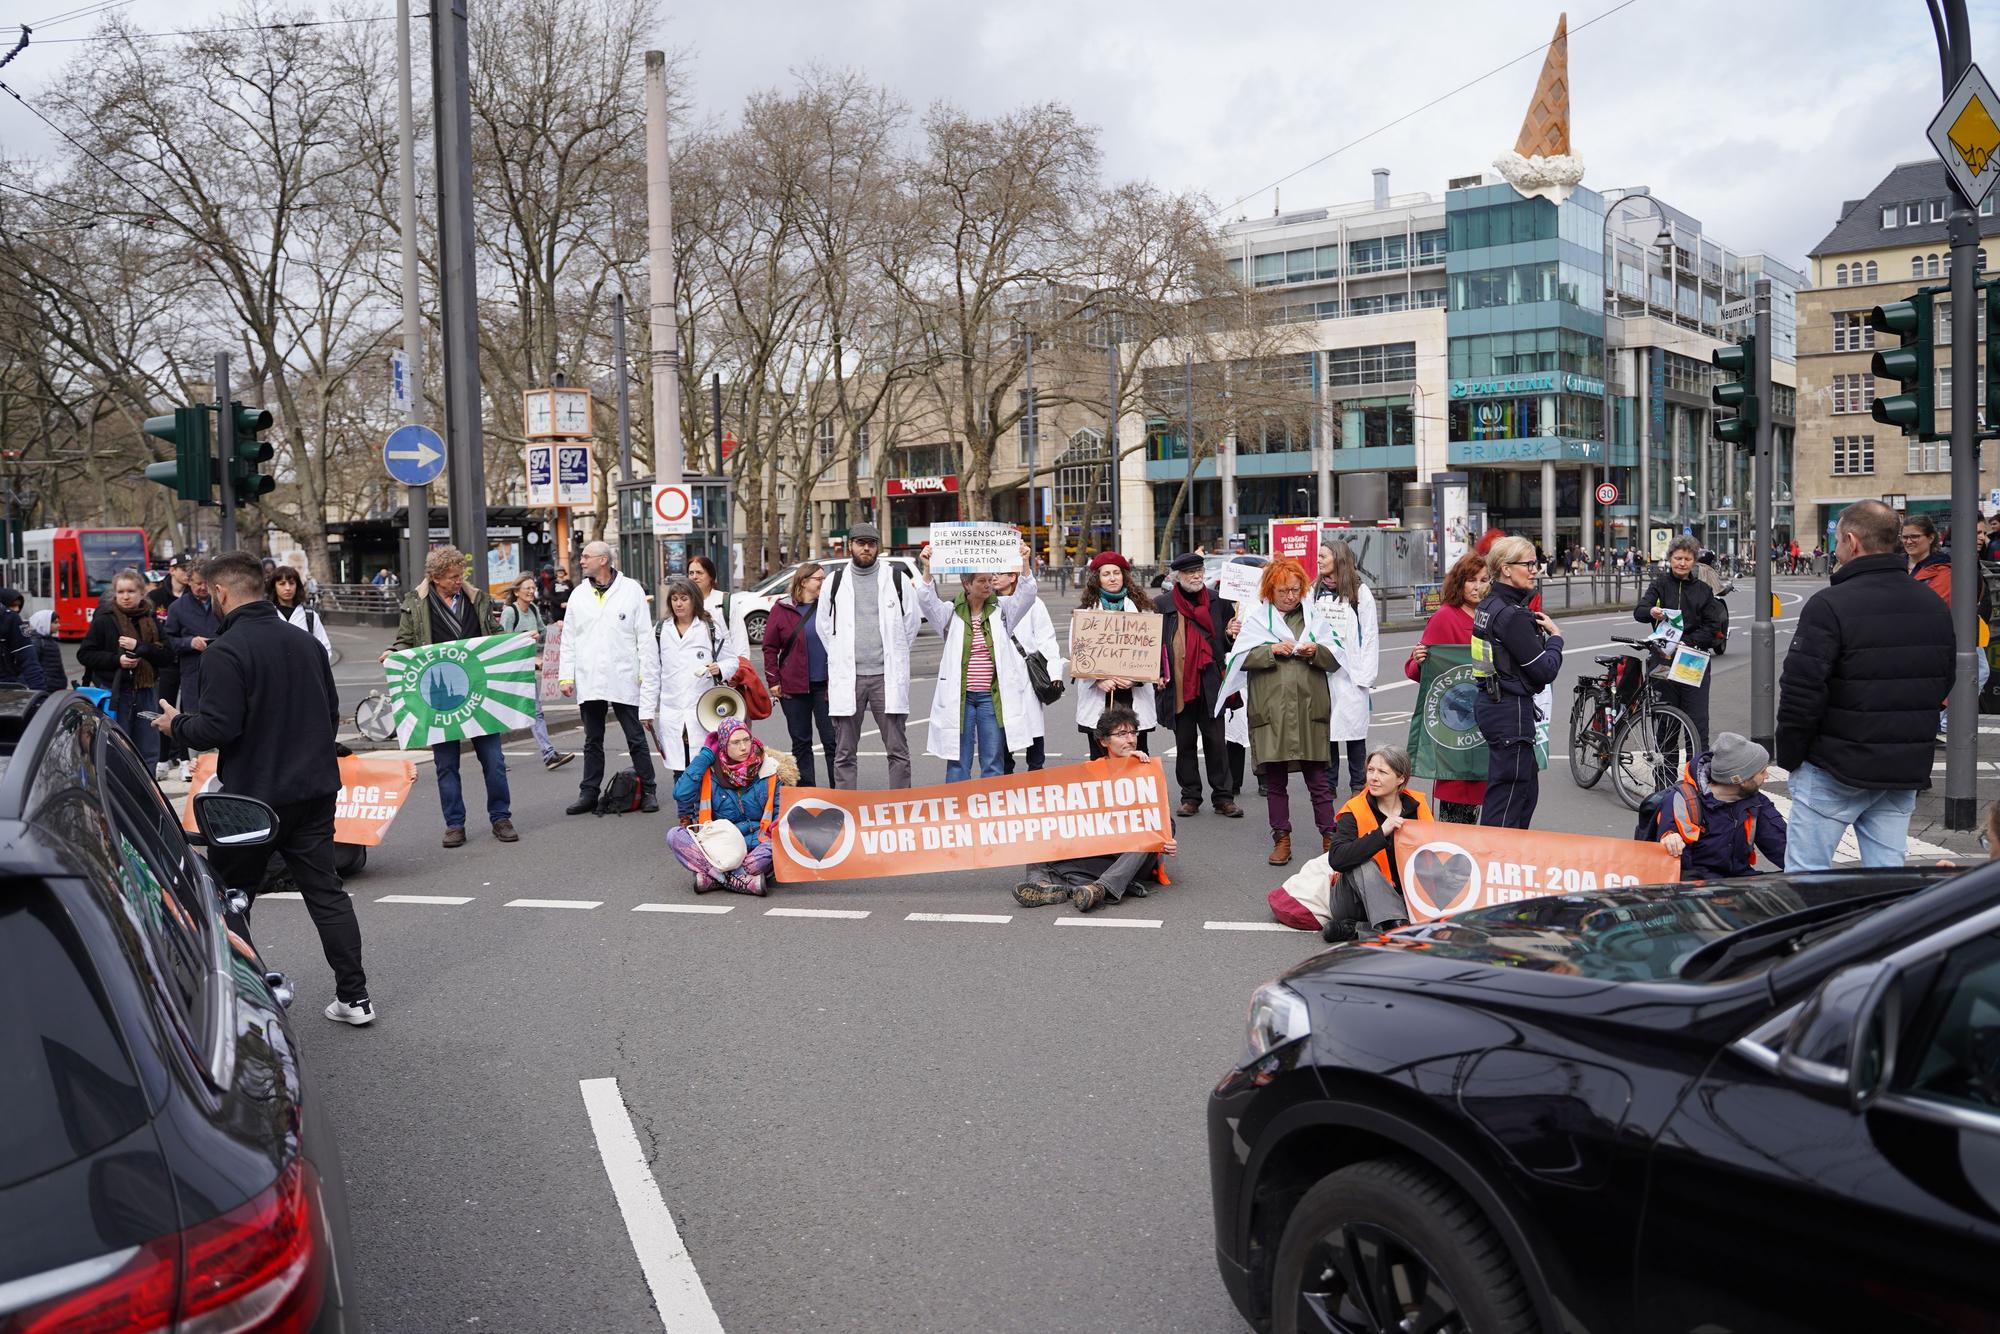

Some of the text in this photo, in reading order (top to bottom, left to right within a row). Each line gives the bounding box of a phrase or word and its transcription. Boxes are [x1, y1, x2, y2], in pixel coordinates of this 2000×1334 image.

[1720, 302, 1752, 320] Neumarkt
[1472, 382, 1498, 394] PAN
[1472, 425, 1508, 433] Mayesche
[530, 450, 547, 469] 97
[560, 449, 583, 468] 97
[1463, 442, 1545, 459] PRIMARK
[1601, 489, 1613, 499] 30
[1081, 616, 1100, 631] DIE
[1095, 632, 1157, 647] ZEITBOMBE
[1088, 645, 1131, 659] TICKT
[401, 647, 468, 692] KÖLLE FOR
[434, 692, 483, 725] FUTURE
[1428, 671, 1462, 728] PARENTS 4
[352, 785, 380, 804] GG
[858, 775, 1158, 828] LETZTE GENERATION
[334, 802, 398, 820] HÜTZEN
[860, 807, 1162, 855] VOR DEN KIPPPUNKTEN
[1486, 861, 1541, 889] ART.
[1546, 867, 1598, 891] 20A
